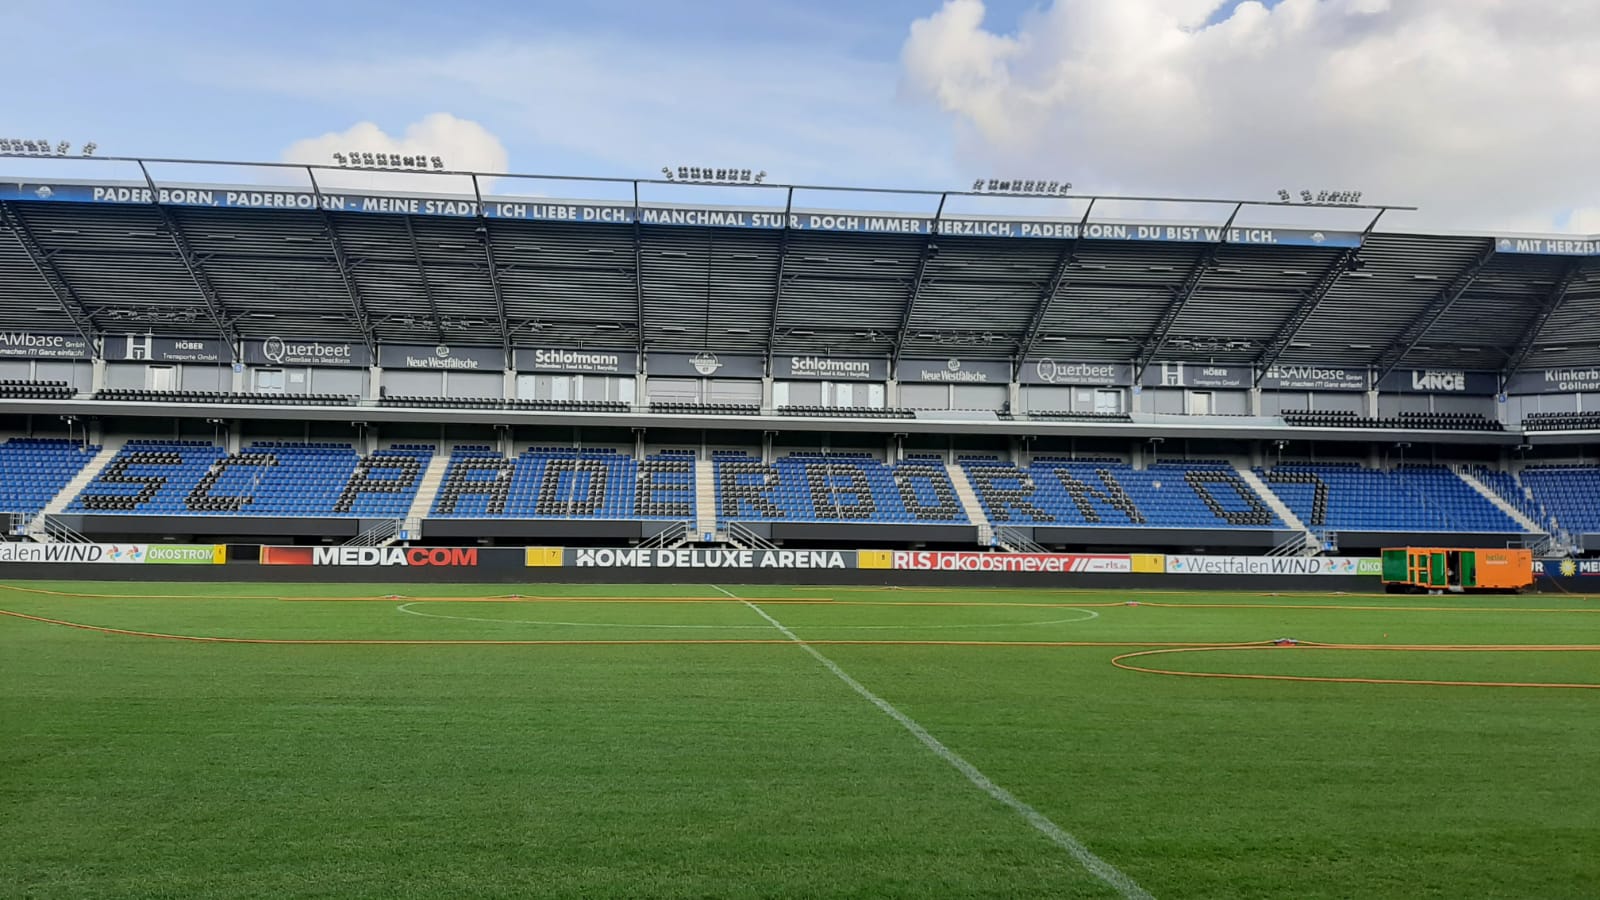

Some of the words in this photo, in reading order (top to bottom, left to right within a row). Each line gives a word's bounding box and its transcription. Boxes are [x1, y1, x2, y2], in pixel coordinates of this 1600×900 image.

[93, 187, 218, 206] PADERBORN,
[226, 191, 345, 209] PADERBORN
[362, 198, 419, 212] MEINE
[425, 201, 489, 217] STADT,
[496, 204, 527, 217] ICH
[533, 205, 577, 219] LIEBE
[583, 207, 630, 221] DICH.
[643, 209, 746, 226] MANCHMAL
[751, 213, 803, 229] STUR,
[810, 216, 859, 229] DOCH
[864, 218, 920, 232] IMMER
[926, 220, 1015, 237] HERZLICH,
[1021, 223, 1131, 240] PADERBORN,
[1138, 228, 1160, 239] DU
[1166, 228, 1200, 240] BIST
[1204, 229, 1240, 241] WIE
[1245, 230, 1278, 243] ICH.
[1516, 240, 1542, 251] MIT
[175, 340, 204, 349] HÖBER
[263, 336, 351, 364] Querbeet
[406, 356, 428, 368] Neue
[535, 349, 618, 365] Schlotmann
[792, 356, 870, 371] Schlotmann
[1037, 358, 1115, 383] Querbeet
[1280, 366, 1344, 380] SAMbase
[1545, 368, 1600, 381] Klinkerb
[0, 543, 102, 561] alenWIND
[149, 546, 214, 560] ÖKOSTROM
[313, 546, 478, 566] MEDIACOM
[576, 549, 651, 567] HOME
[656, 549, 753, 568] DELUXE
[760, 551, 846, 569] ARENA
[895, 552, 931, 569] RLS
[932, 552, 1069, 571] Jakobsmeyer
[1186, 557, 1320, 574] WestfalenWIND
